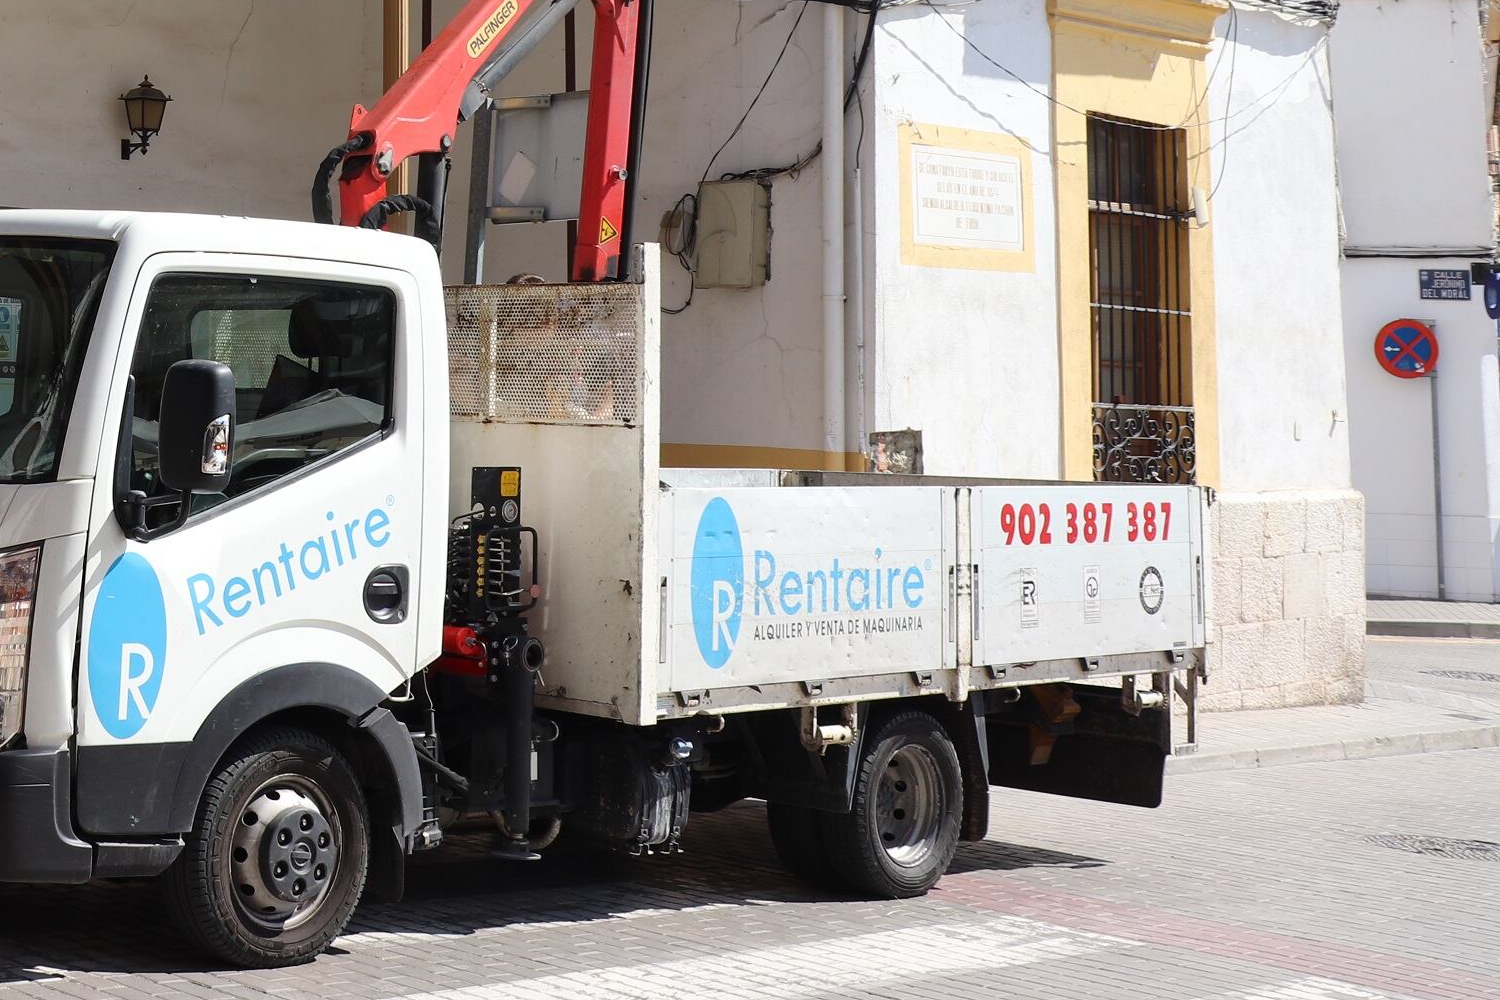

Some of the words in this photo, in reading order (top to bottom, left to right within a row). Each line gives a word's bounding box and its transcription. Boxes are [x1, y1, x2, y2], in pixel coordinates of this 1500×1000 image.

[470, 0, 516, 55] PALFINGER
[1422, 289, 1438, 298] DEL
[1441, 289, 1468, 298] MORAL
[1000, 503, 1052, 546] 902
[1066, 502, 1113, 544] 387
[1126, 502, 1171, 542] 387
[186, 508, 391, 636] Rentaire
[754, 548, 924, 616] Rentaire
[712, 580, 737, 652] R
[754, 623, 802, 641] ALQUILER
[806, 622, 812, 636] Y
[814, 620, 844, 636] VENTA
[848, 619, 860, 634] DE
[863, 616, 922, 634] MAQUINARIA
[118, 642, 154, 720] R
